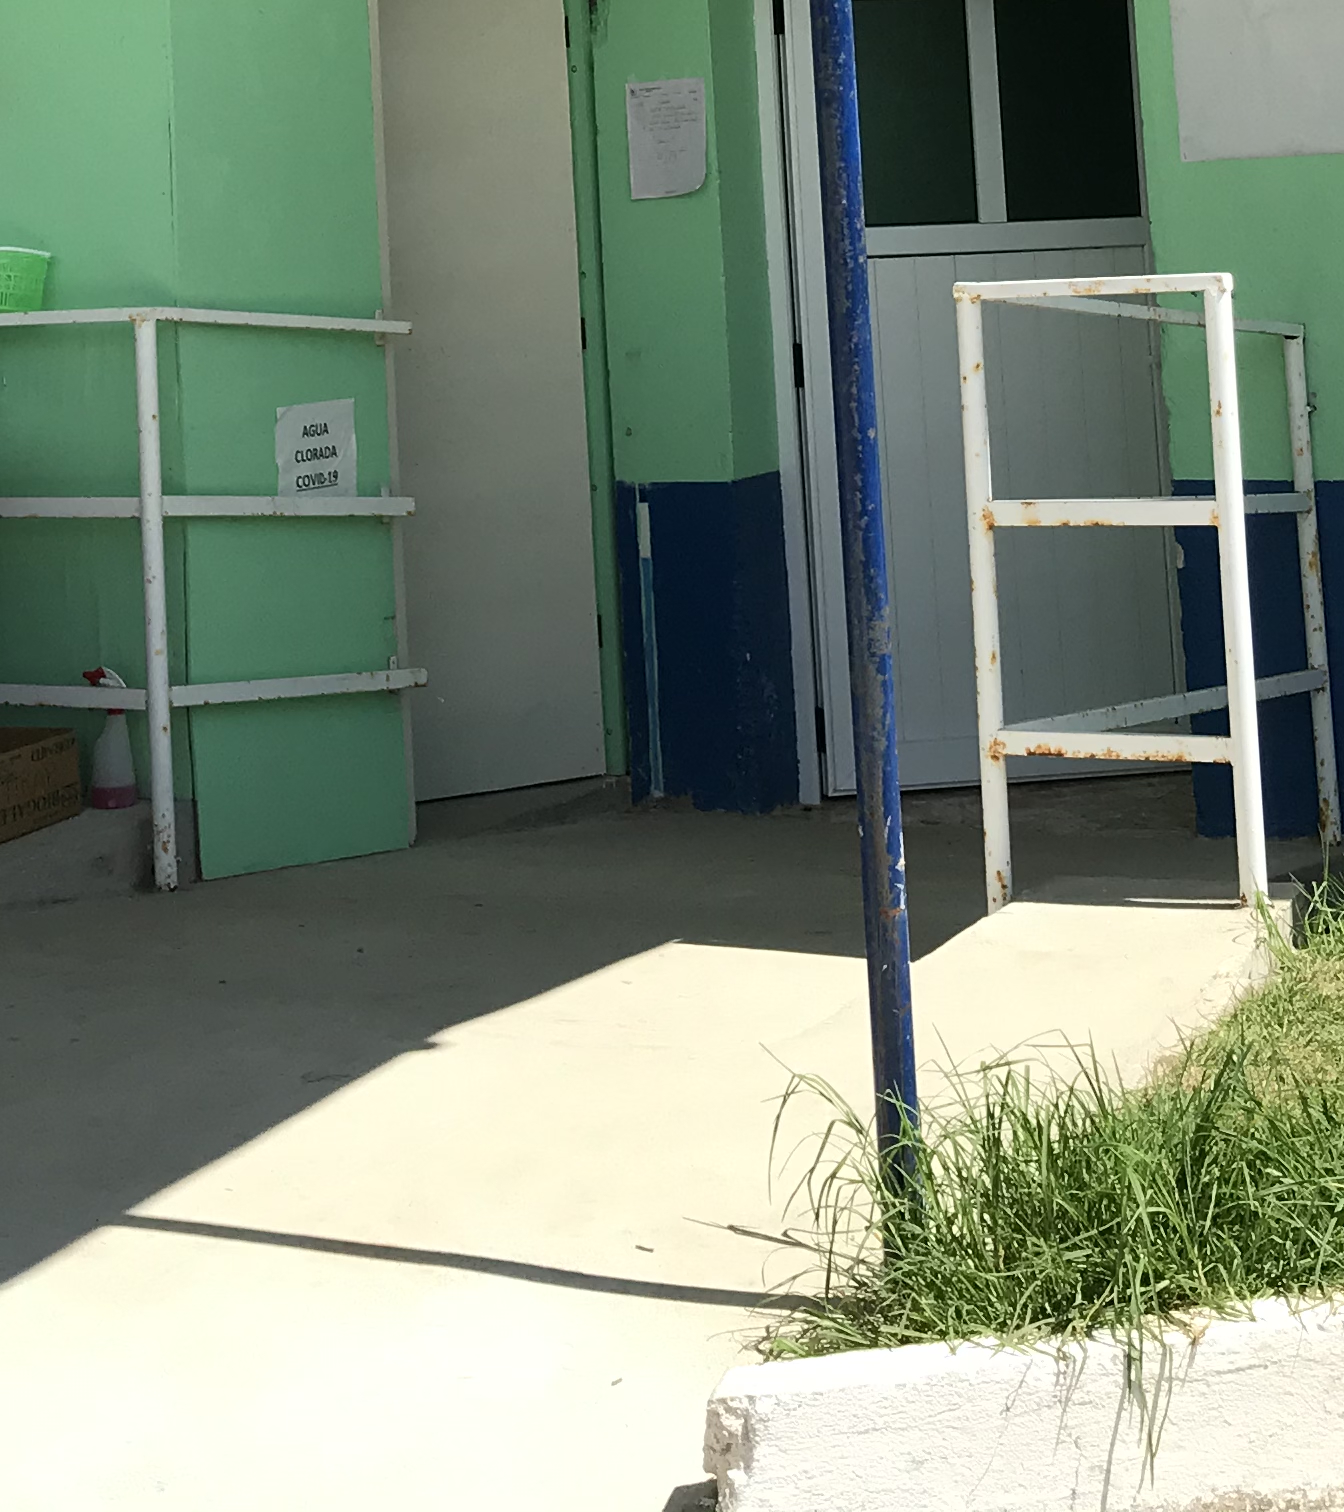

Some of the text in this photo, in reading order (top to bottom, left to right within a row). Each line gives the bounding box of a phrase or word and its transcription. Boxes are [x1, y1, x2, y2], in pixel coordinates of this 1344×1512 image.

[301, 422, 329, 438] AGUA
[294, 444, 338, 464] CLORADA
[296, 469, 339, 489] COVID-19
